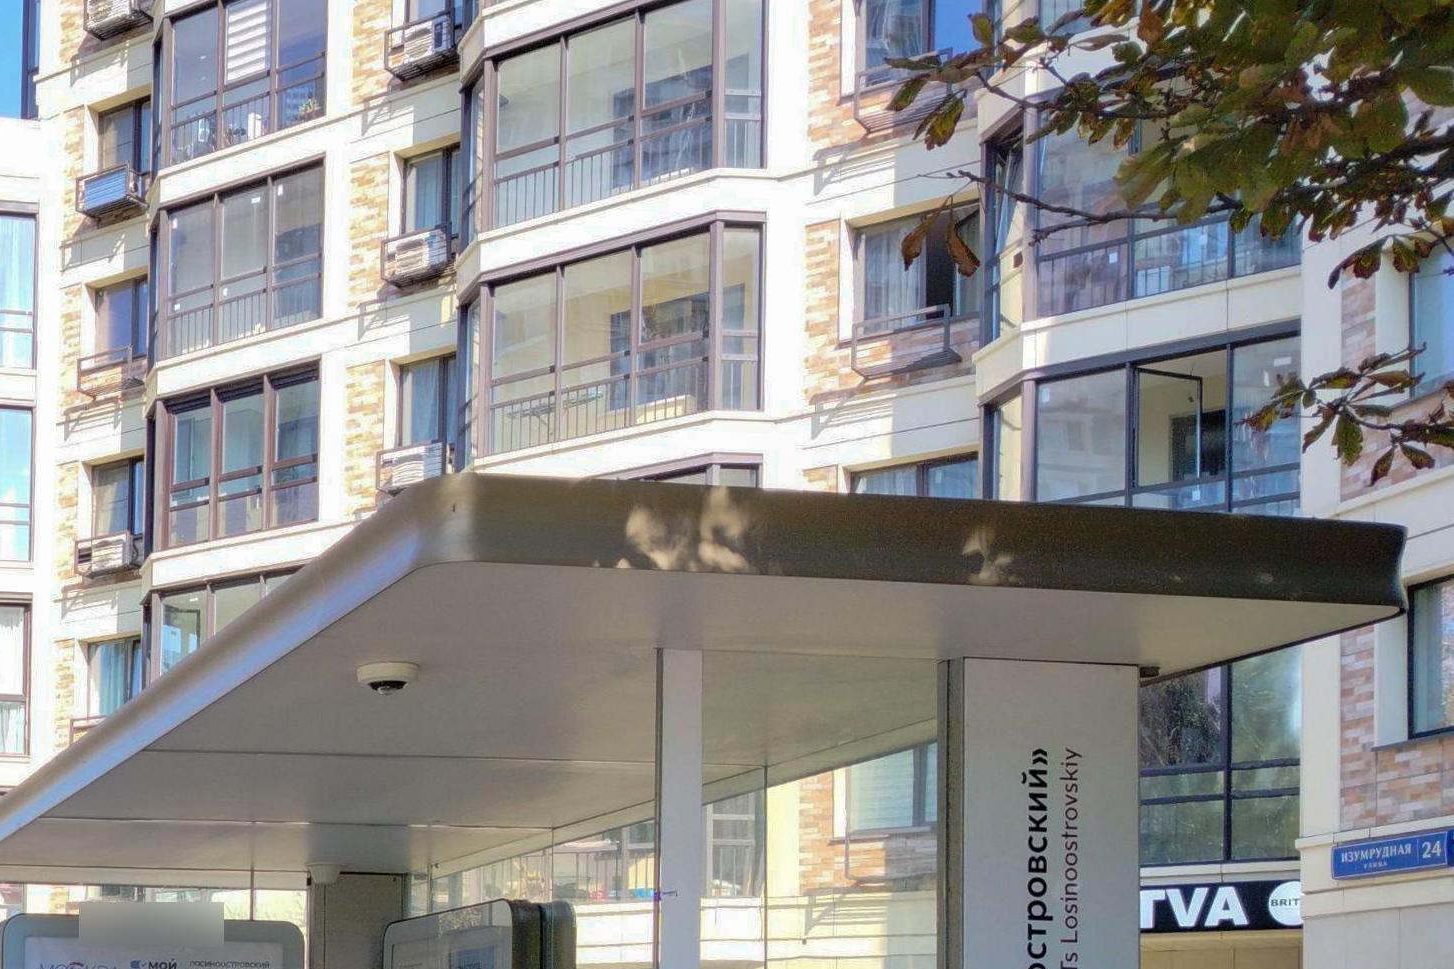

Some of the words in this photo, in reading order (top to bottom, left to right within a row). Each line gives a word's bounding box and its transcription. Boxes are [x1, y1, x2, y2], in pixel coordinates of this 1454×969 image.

[1060, 748, 1083, 943] Losinoostrovskiy
[1341, 843, 1412, 863] ИЗУМРУДНАЯ
[1421, 840, 1442, 859] 24
